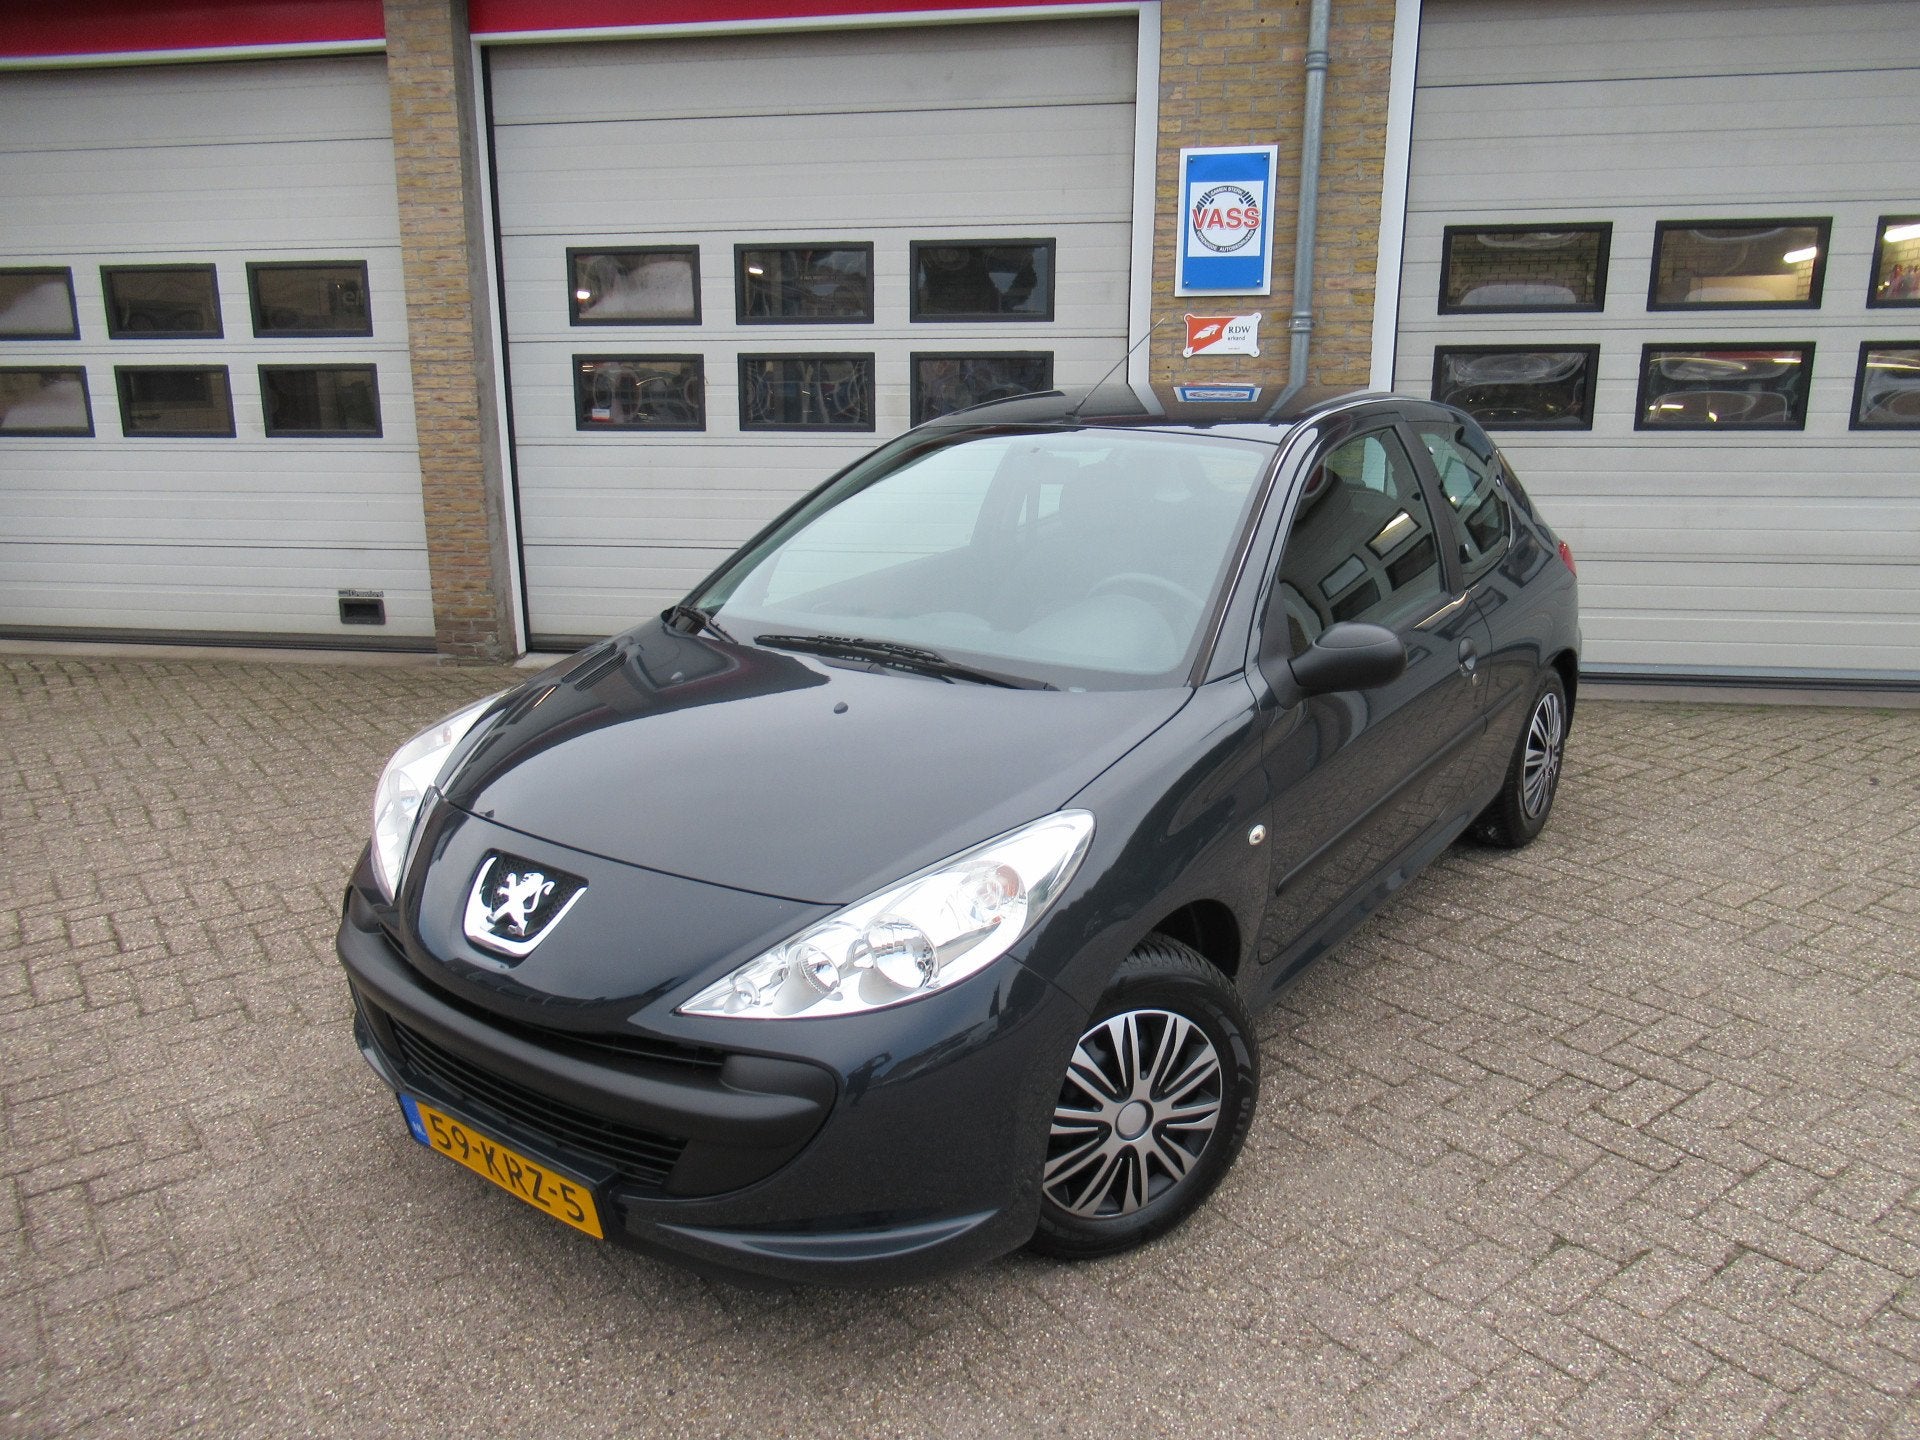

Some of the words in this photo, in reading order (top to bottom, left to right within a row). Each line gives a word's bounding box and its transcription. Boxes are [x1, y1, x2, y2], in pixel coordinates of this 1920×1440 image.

[1192, 207, 1260, 229] VASS
[1228, 326, 1251, 334] RDW
[412, 1121, 428, 1136] NL
[428, 1114, 585, 1222] 59-KRZ-5
